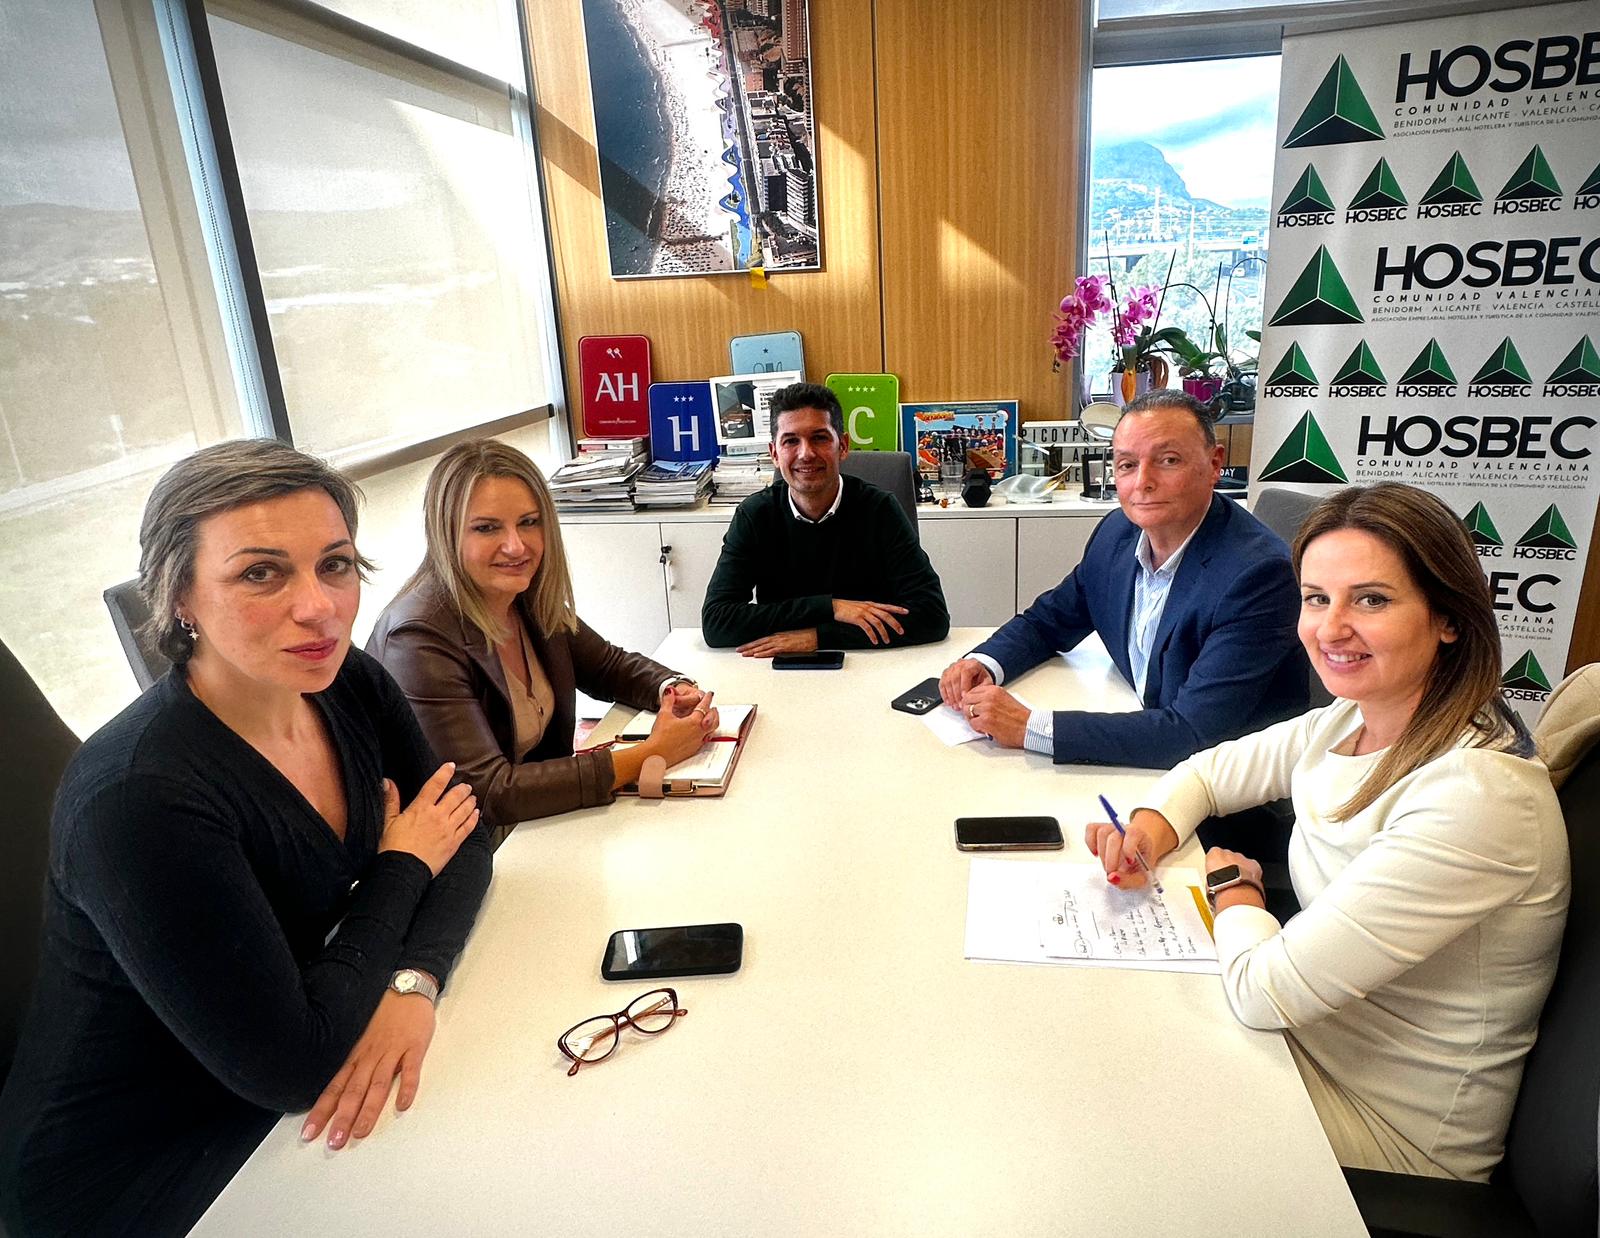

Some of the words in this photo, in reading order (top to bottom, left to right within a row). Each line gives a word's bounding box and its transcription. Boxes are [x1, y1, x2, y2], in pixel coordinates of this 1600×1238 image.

[1395, 32, 1600, 104] HOSBE
[1395, 98, 1510, 117] COMUNIDAD
[1526, 89, 1600, 105] VALENC
[1393, 117, 1447, 129] BENIDORM
[1457, 111, 1511, 123] ALICANTE
[1522, 106, 1577, 117] VALENCIA
[1416, 203, 1483, 219] HOSBEC
[1493, 197, 1562, 215] HOSBEC
[1277, 212, 1336, 228] HOSBEC
[1345, 208, 1408, 224] HOSBEC
[1373, 292, 1481, 304] COMUNIDAD
[1496, 288, 1600, 300] VALENCIA
[1372, 306, 1423, 314] BENIDORM
[1432, 304, 1482, 313] ALICANTE
[1492, 302, 1545, 311] VALENCIA
[1555, 300, 1600, 309] CASTELL
[595, 372, 639, 402] AH
[1263, 386, 1319, 399] HOSBEC
[1328, 385, 1387, 398] HOSBEC
[1395, 385, 1457, 398] HOSBEC
[1467, 385, 1532, 398] HOSBEC
[1542, 384, 1600, 398] HOSBE
[848, 406, 875, 445] C
[667, 415, 700, 452] H
[1021, 427, 1099, 442] PICOYPA
[1357, 415, 1598, 460] HOSBEC
[1357, 459, 1459, 470] COMUNIDAD
[1472, 462, 1590, 472] VALENCIANA
[1412, 471, 1460, 479] ALICANTE
[1469, 472, 1519, 480] VALENCIA
[1513, 547, 1577, 561] HOSBEC
[1501, 614, 1554, 624] CIANA
[1501, 688, 1551, 702] OSBEC
